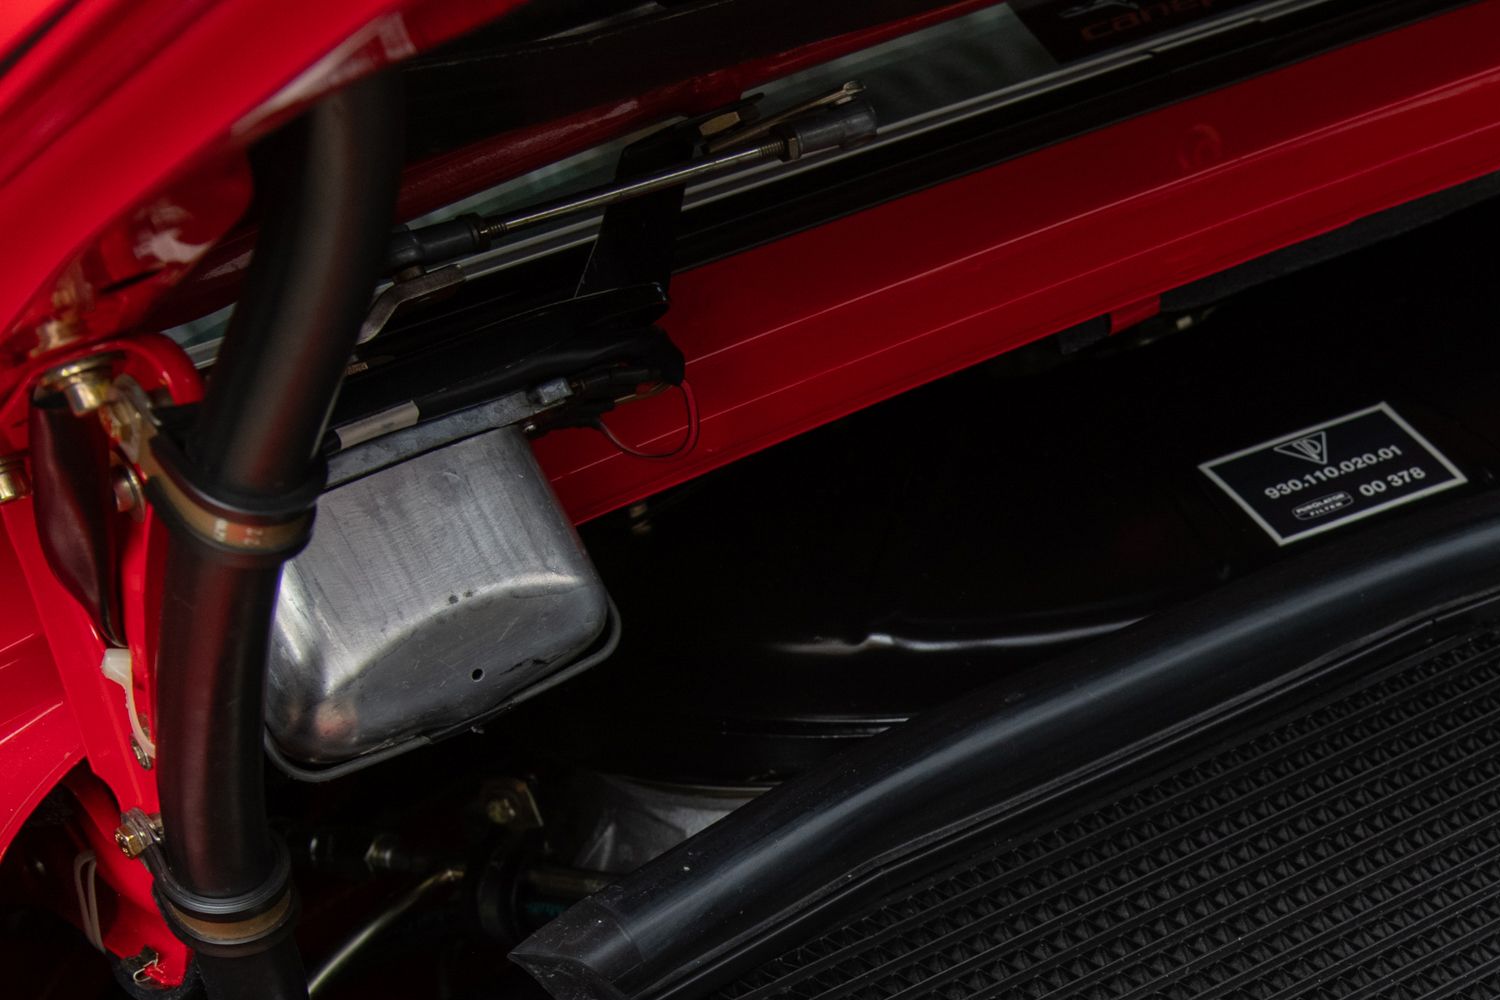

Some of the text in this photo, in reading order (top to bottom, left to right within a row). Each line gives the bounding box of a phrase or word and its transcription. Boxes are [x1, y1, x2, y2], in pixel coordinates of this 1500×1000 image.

[1264, 445, 1402, 499] 930.110.020.01
[1358, 466, 1426, 497] 00 378
